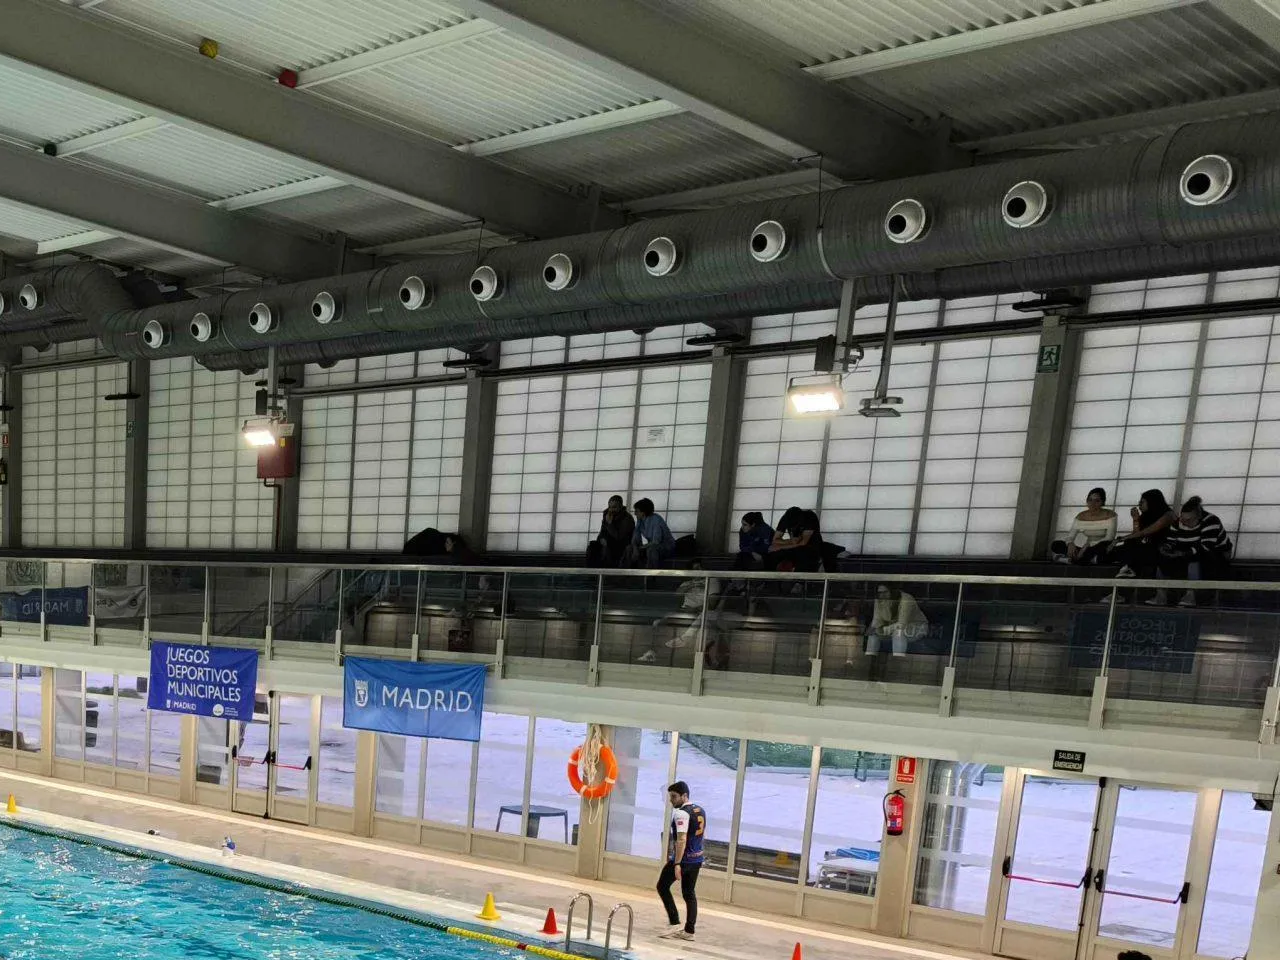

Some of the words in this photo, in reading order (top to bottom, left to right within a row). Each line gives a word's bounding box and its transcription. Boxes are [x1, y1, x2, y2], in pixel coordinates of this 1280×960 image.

[166, 646, 210, 664] JUEGOS
[167, 664, 238, 684] DEPORTIVOS
[167, 680, 241, 702] MUNICIPALES
[382, 685, 473, 713] MADRID
[173, 701, 197, 711] MADRID
[695, 815, 704, 836] 3
